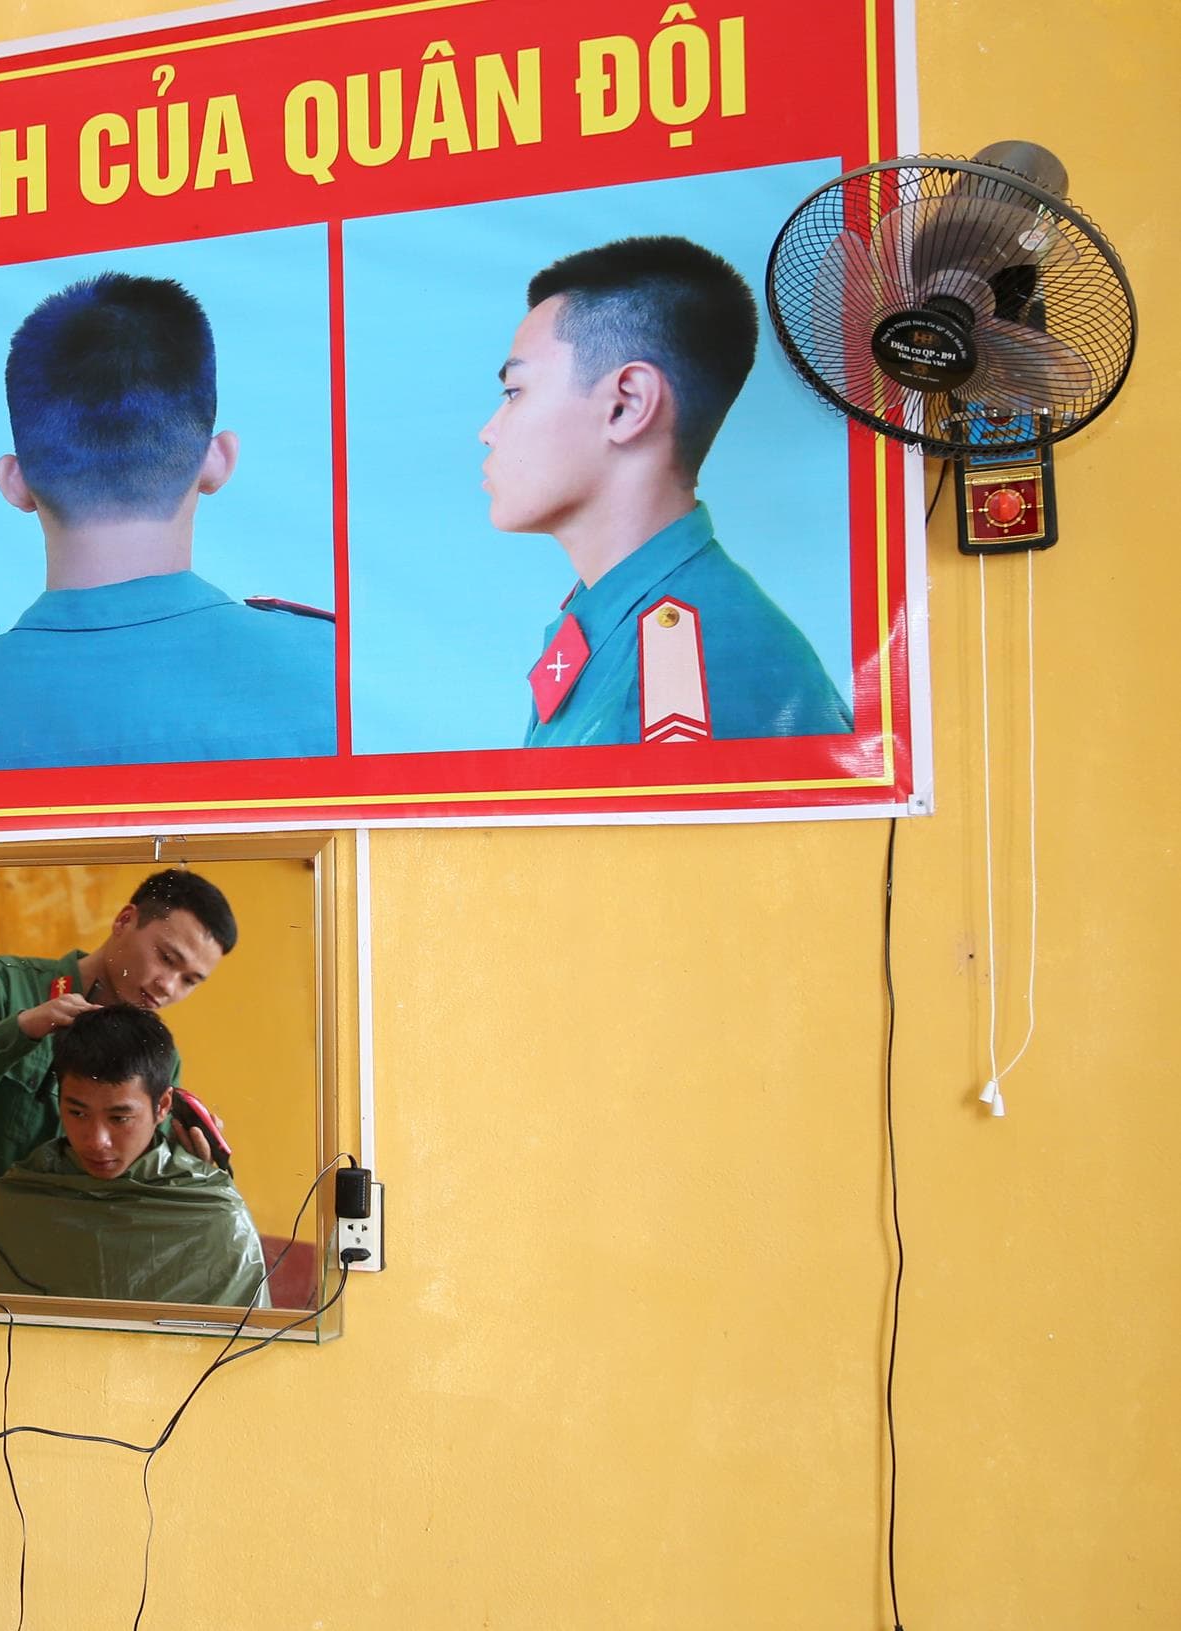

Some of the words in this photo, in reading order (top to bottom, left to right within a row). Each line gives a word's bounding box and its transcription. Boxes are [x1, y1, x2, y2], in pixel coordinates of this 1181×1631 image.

[79, 64, 254, 205] CỦA
[284, 39, 542, 185] QUÂN
[575, 2, 746, 148] ĐỘI
[922, 348, 936, 358] QP
[941, 352, 956, 361] B91
